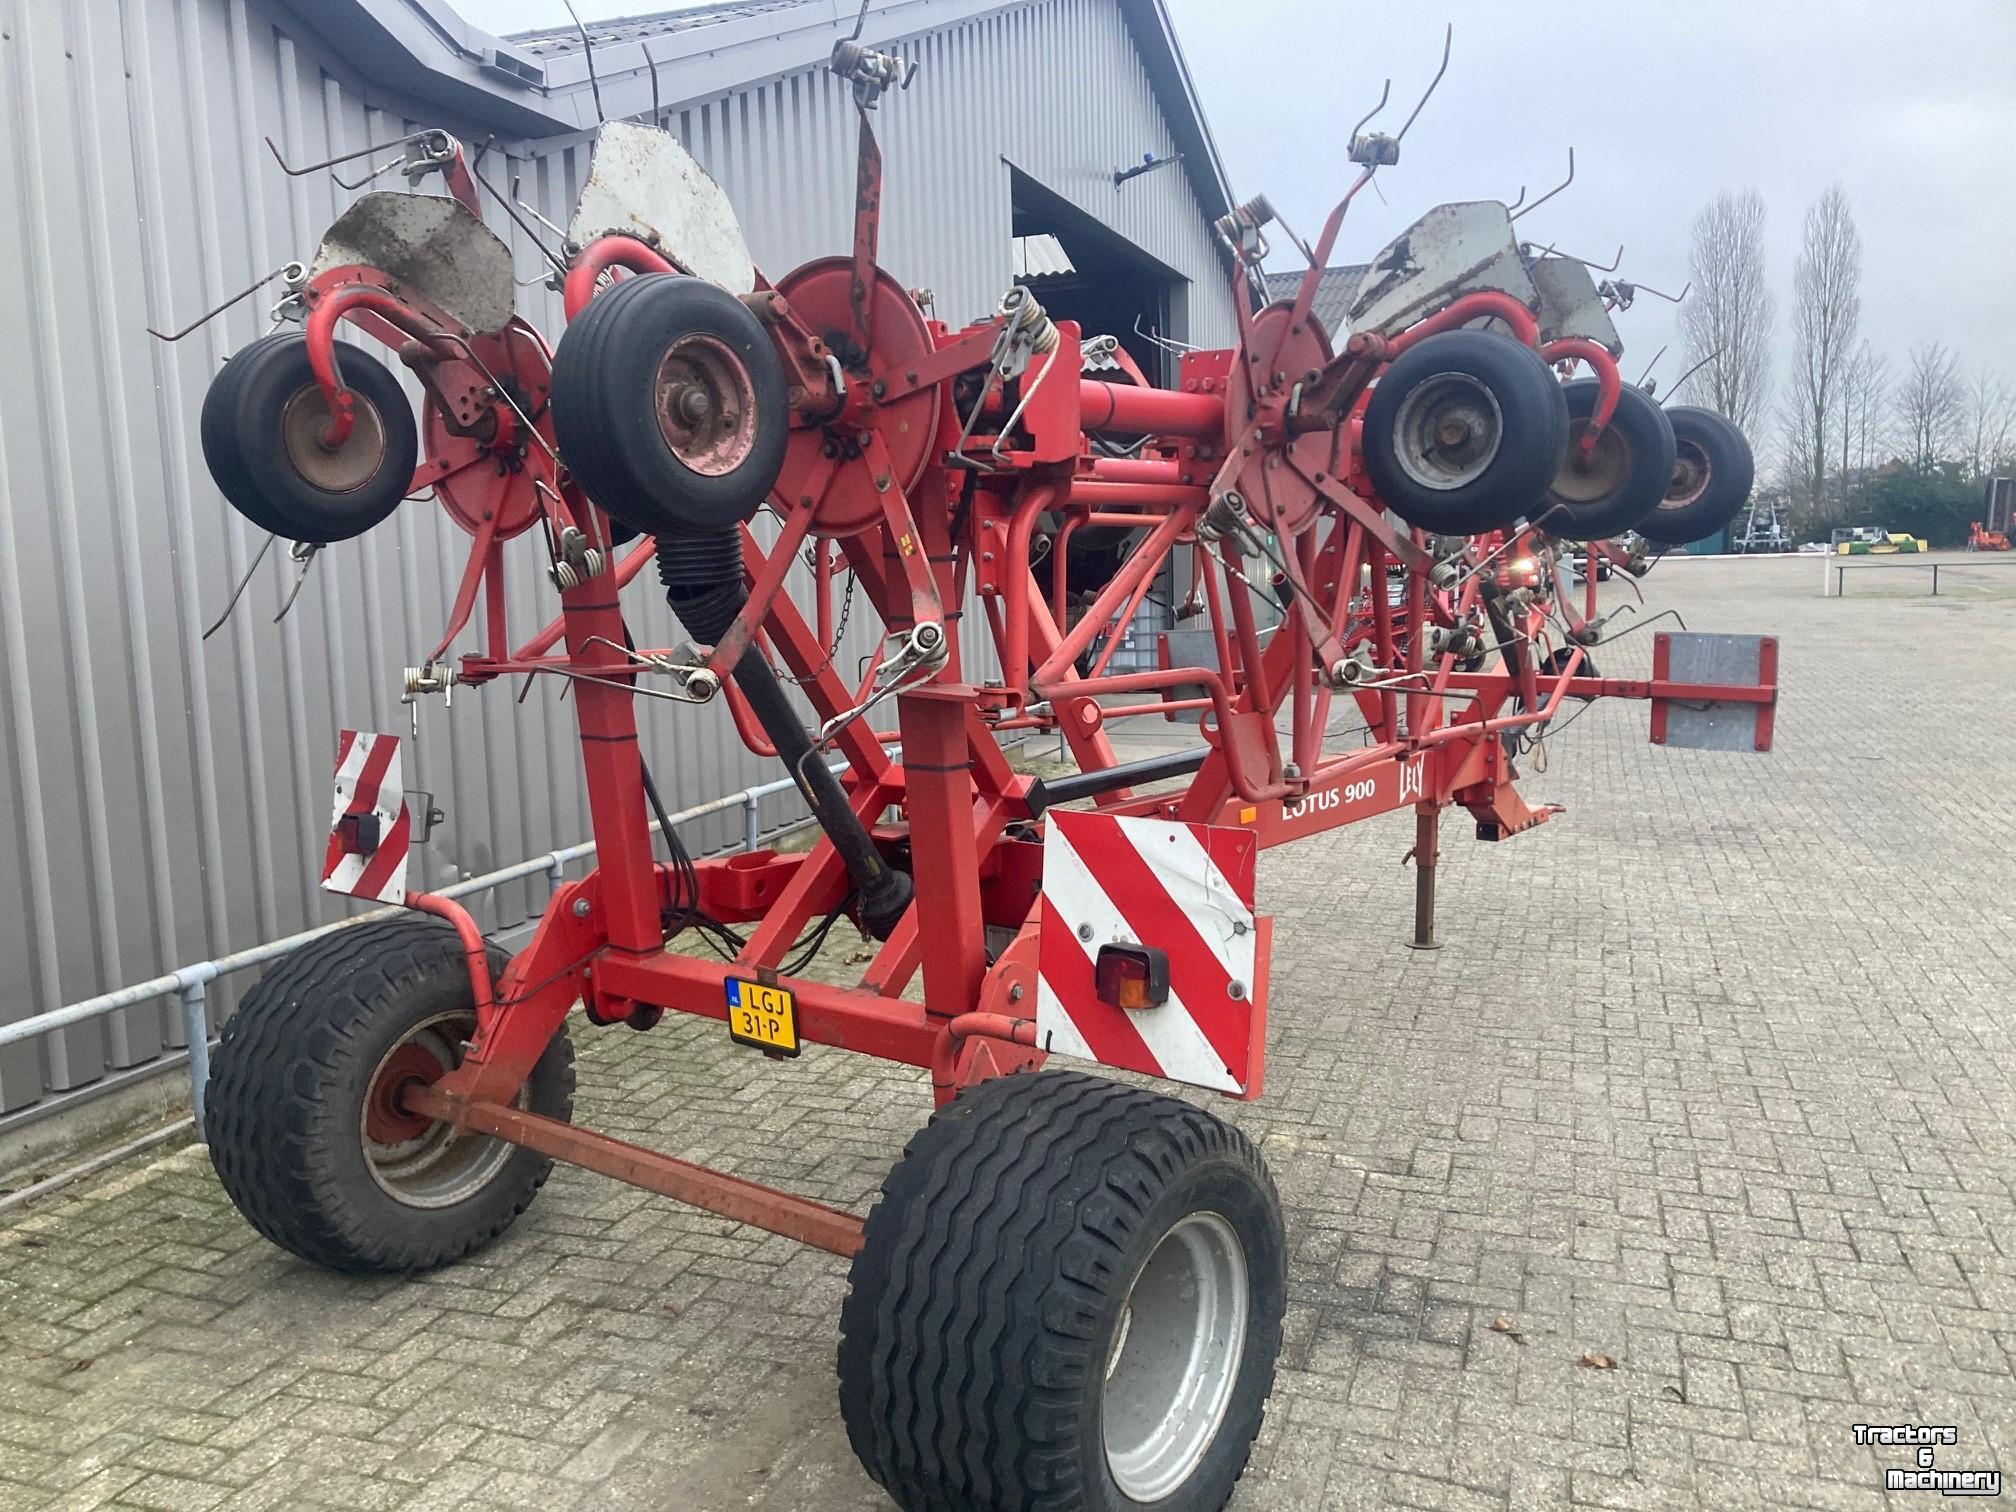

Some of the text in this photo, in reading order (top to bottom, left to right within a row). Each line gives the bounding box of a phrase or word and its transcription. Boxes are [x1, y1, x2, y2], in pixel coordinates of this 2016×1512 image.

[1399, 752, 1425, 804] LELY
[1282, 779, 1376, 821] LOTUS 900
[749, 987, 784, 1016] LGJ
